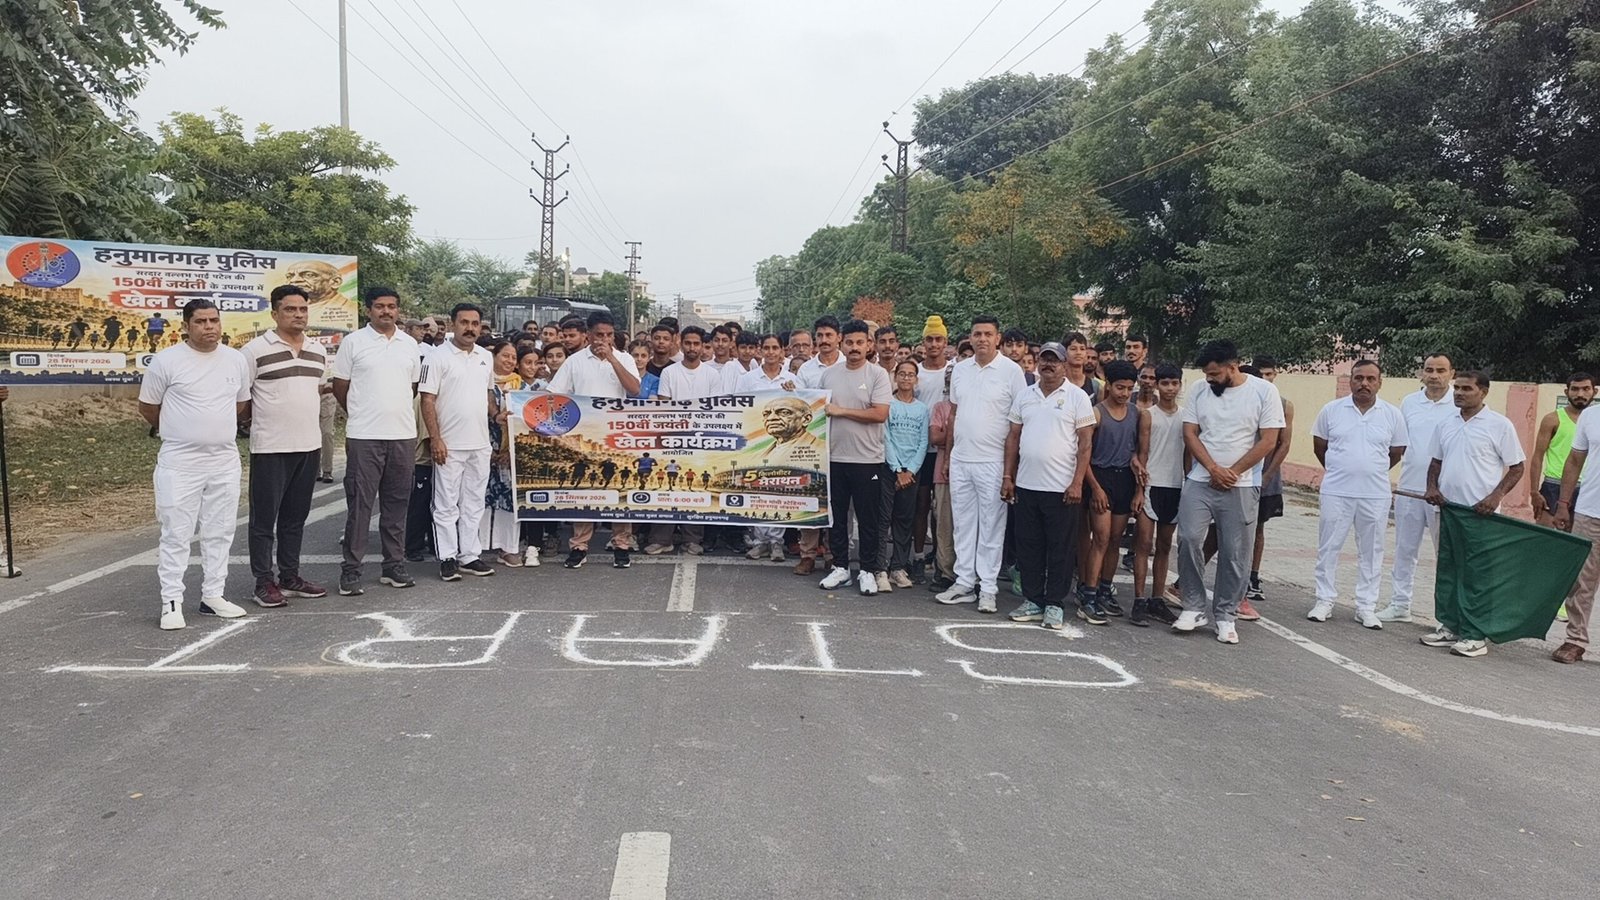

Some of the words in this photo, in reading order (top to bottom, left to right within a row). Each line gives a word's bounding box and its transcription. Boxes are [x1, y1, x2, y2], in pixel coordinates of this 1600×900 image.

[93, 247, 211, 268] हनुमानगढ़
[216, 251, 277, 271] पुलिस
[112, 276, 162, 289] 150वीं
[166, 278, 207, 290] जयंती
[209, 282, 219, 290] के
[120, 290, 169, 308] खेल
[607, 419, 651, 430] 150वीं
[653, 419, 690, 430] जयंती
[692, 421, 701, 429] के
[735, 421, 743, 430] में
[614, 432, 657, 449] खेल
[660, 432, 738, 450] कार्यक्रम
[744, 470, 758, 482] 5
[43, 609, 1139, 690] START
